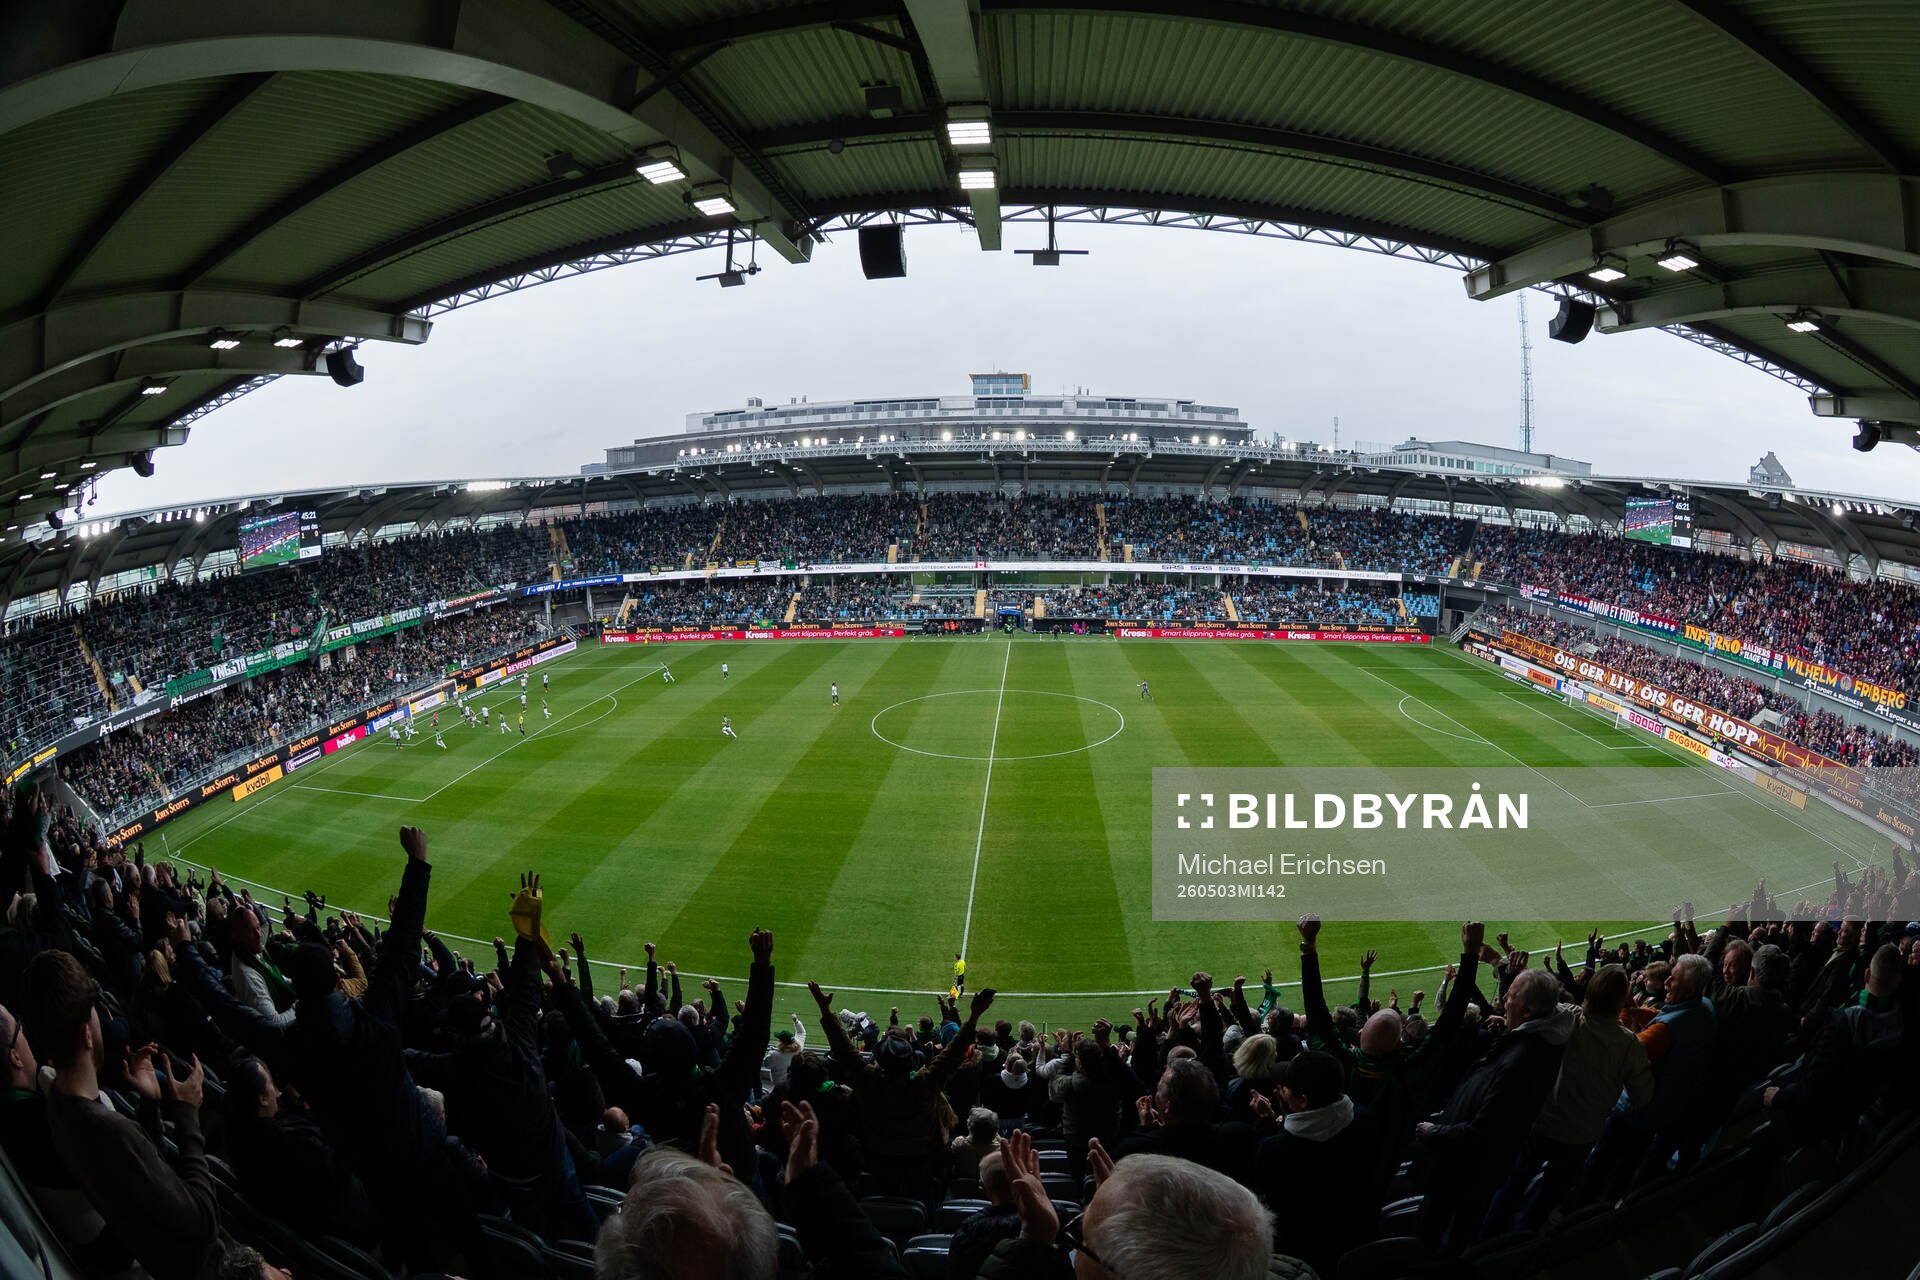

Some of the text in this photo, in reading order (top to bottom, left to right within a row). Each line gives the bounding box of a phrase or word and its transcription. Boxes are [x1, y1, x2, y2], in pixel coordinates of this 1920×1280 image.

[1588, 600, 1640, 625] AMOR ET FIDES
[329, 627, 351, 640] TIFO
[508, 658, 531, 673] BEVEGO
[1787, 655, 1838, 687] WILHELM
[1854, 680, 1905, 708] FRIBERG
[1554, 651, 1575, 671] ÖIS
[1579, 662, 1605, 682] GER
[1640, 684, 1667, 706] ÖIS
[1672, 699, 1704, 724] GER
[1709, 714, 1758, 746] HOPP
[1889, 713, 1906, 723] SPORT
[1668, 730, 1709, 756] BYGGMAX
[246, 773, 270, 793] kvdbil
[1767, 779, 1793, 801] kvdbil
